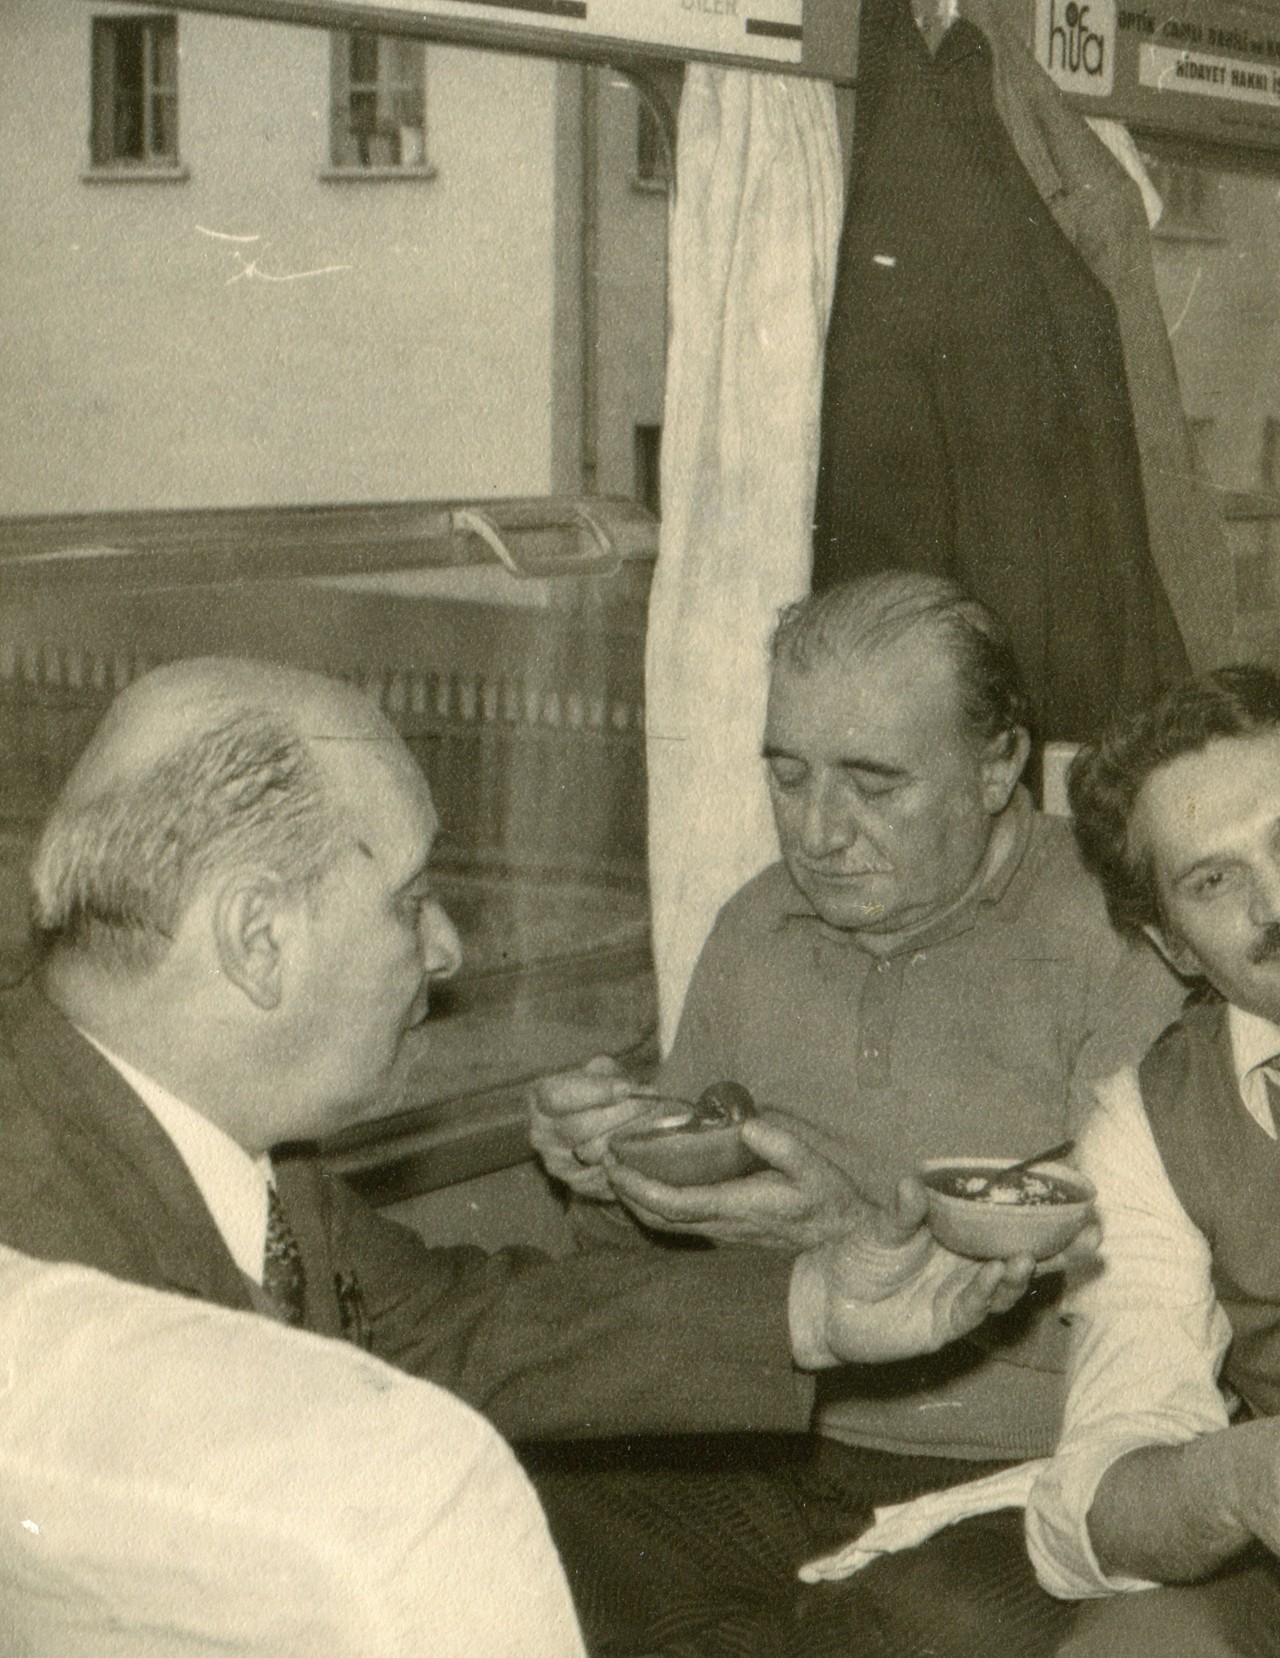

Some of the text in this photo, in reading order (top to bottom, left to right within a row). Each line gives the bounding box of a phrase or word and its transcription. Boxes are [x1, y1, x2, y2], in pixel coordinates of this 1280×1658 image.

[1048, 0, 1104, 77] hifa
[1175, 53, 1226, 85] HİDAYET
[1230, 68, 1268, 91] HAKKI
